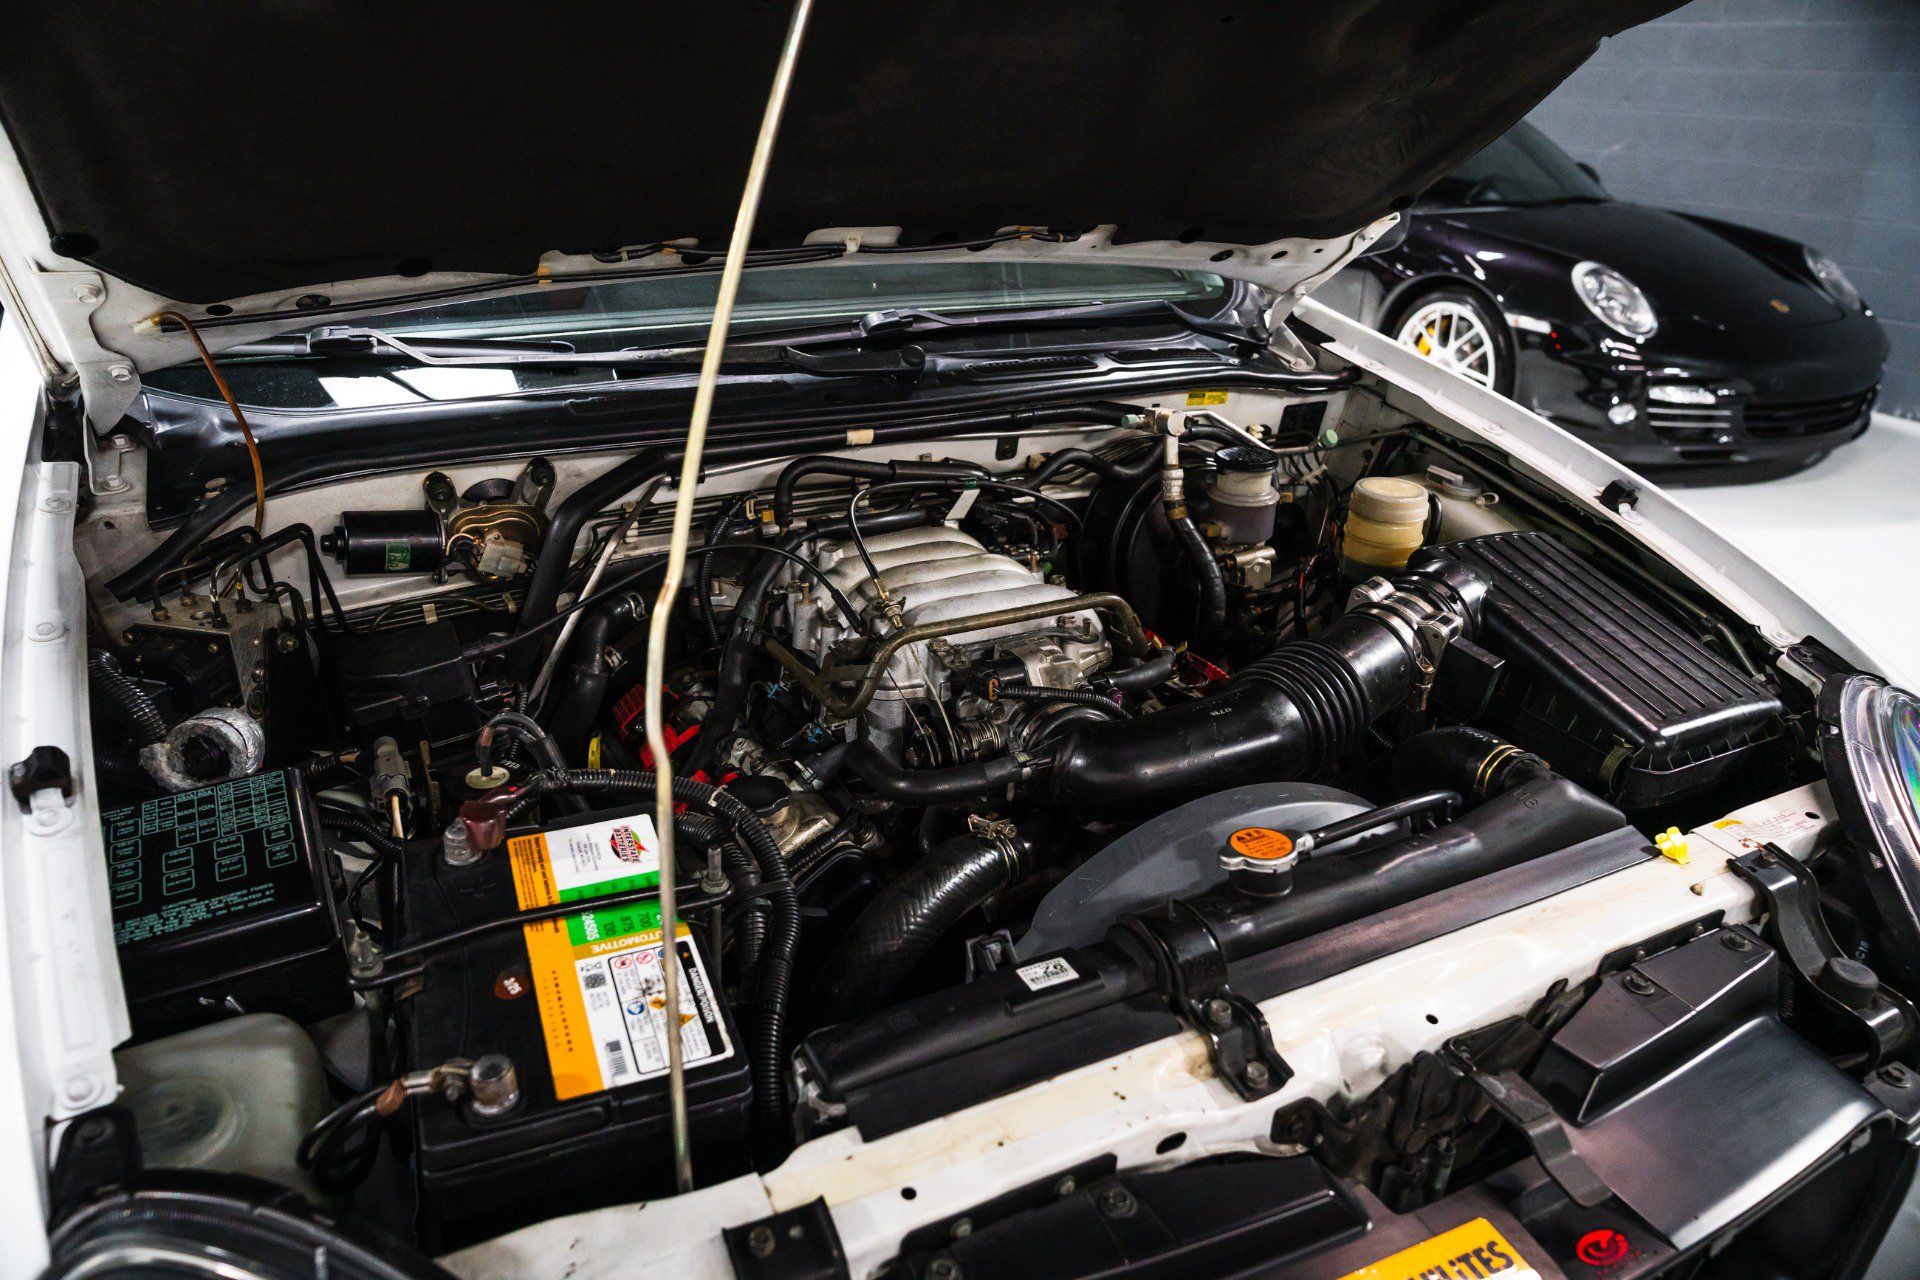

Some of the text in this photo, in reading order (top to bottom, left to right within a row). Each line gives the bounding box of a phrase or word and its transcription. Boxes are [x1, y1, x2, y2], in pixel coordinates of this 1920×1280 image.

[176, 808, 196, 816] MAIN
[613, 827, 630, 863] BATTERIES
[621, 825, 642, 864] INTERSTATE
[162, 898, 197, 910] CAUTION
[604, 920, 617, 937] 130
[621, 914, 635, 933] 875
[638, 911, 652, 929] 700
[592, 930, 665, 954] UTOMOTIVE
